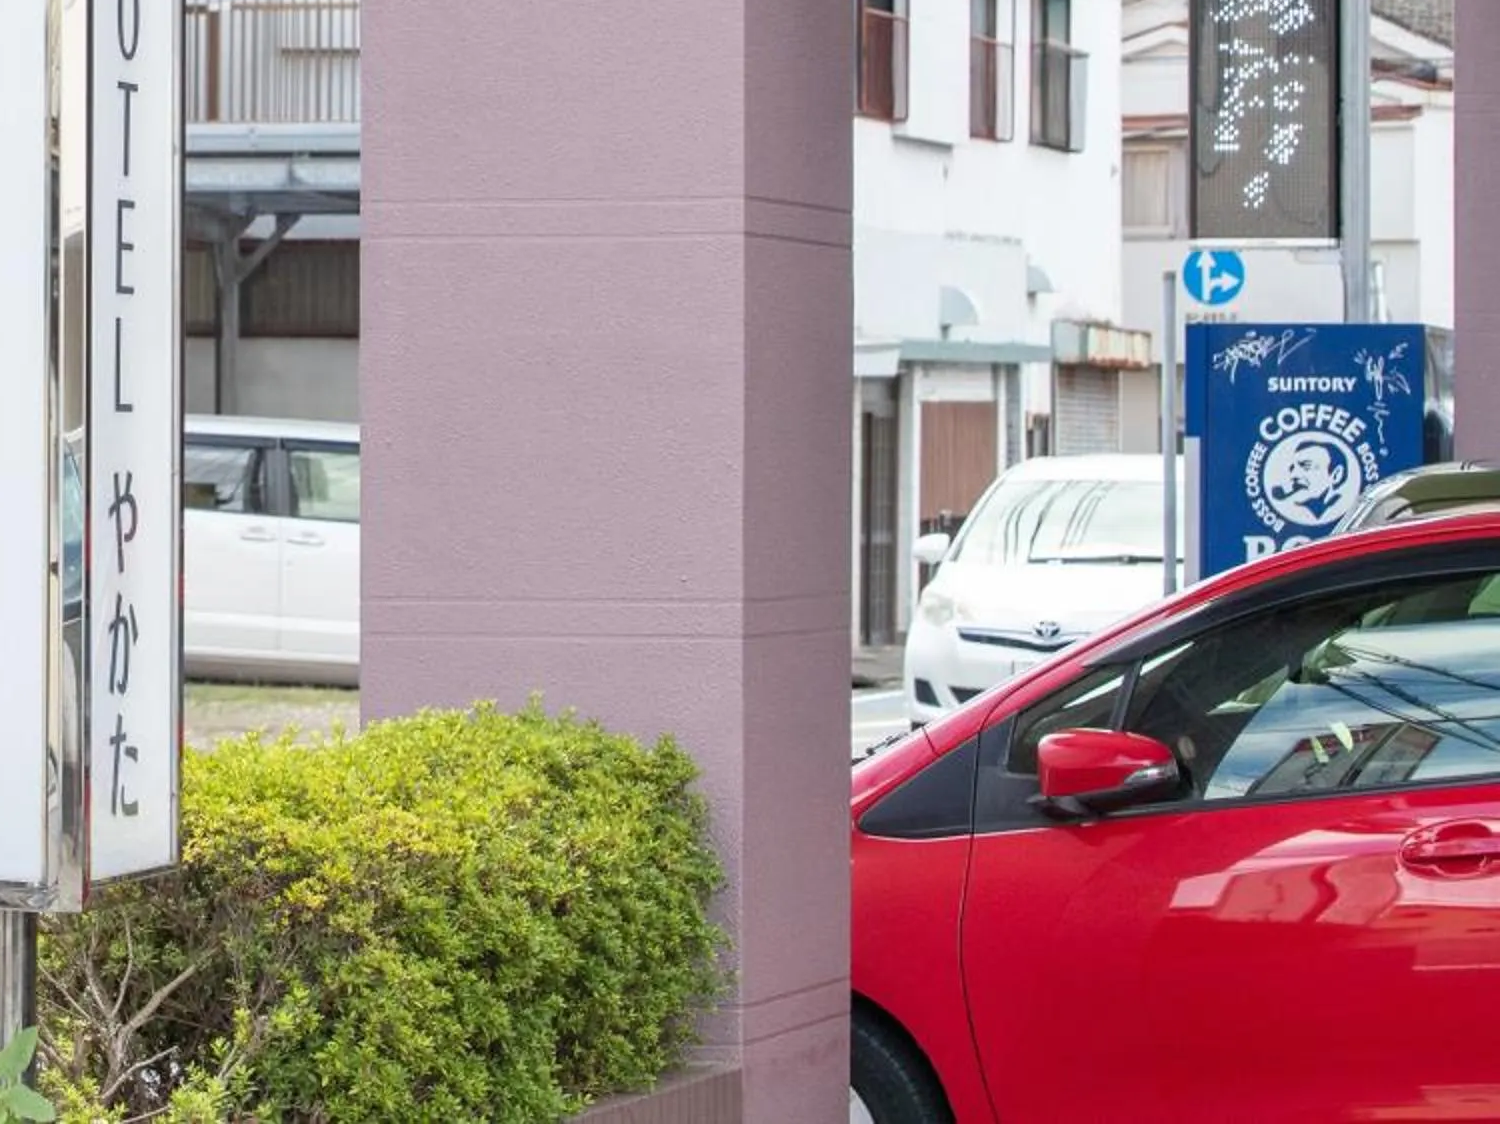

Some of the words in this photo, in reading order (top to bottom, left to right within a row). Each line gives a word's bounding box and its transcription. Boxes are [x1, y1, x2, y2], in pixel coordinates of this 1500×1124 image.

[1259, 403, 1366, 442] COFFEE
[108, 470, 139, 817] やかた
